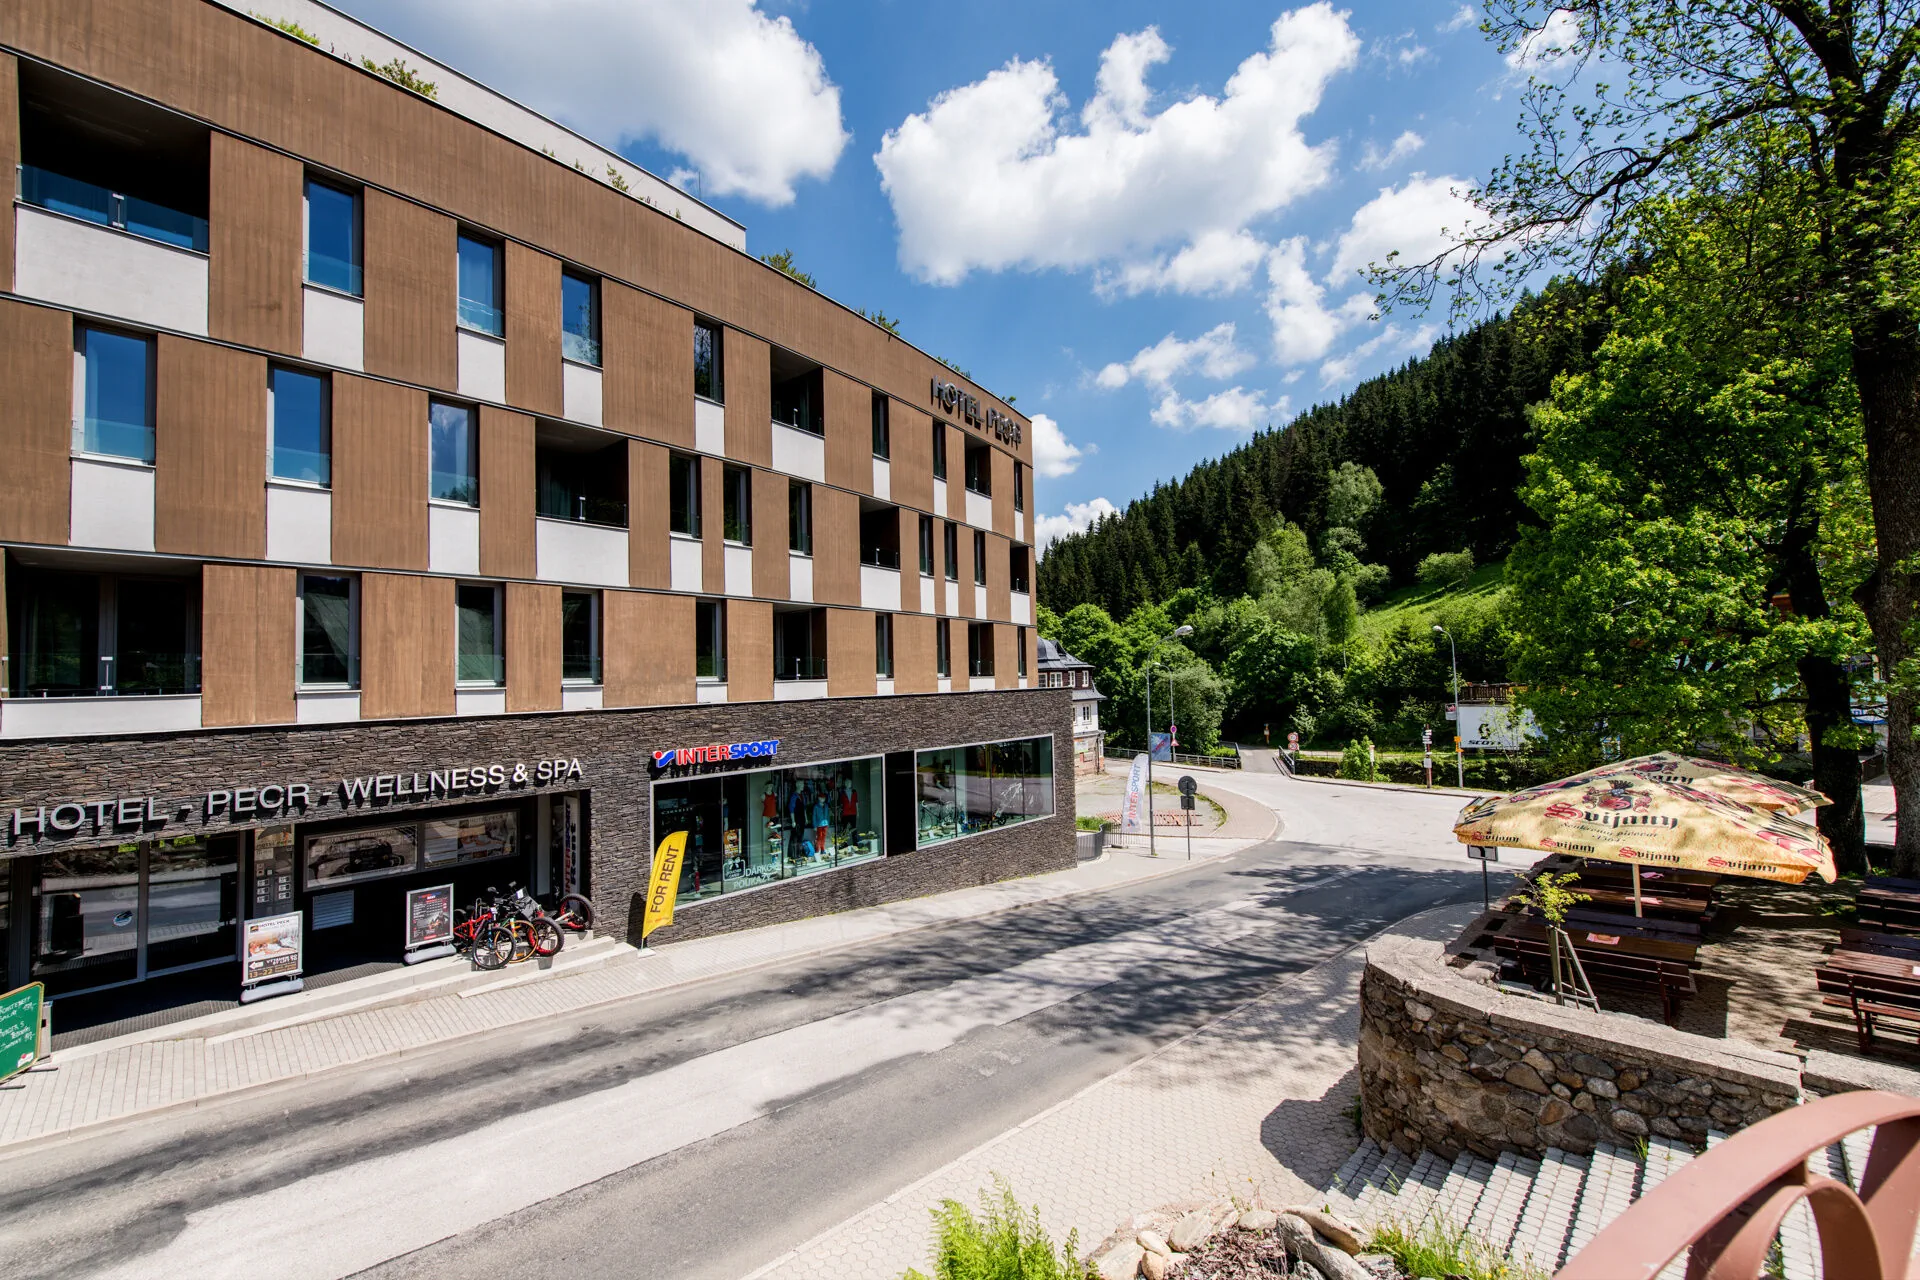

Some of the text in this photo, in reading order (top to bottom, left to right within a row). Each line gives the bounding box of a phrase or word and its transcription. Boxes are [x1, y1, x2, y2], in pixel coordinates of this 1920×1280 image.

[932, 376, 985, 423] HOTEL
[676, 740, 780, 766] INTERSPORT
[13, 796, 170, 836] HOTEL
[206, 783, 311, 815] PECR
[342, 764, 505, 801] WELLNESS
[512, 763, 529, 783] &
[536, 757, 583, 780] SPA
[1128, 763, 1141, 819] INTERSPORT
[1543, 802, 1678, 830] Svijany
[1471, 831, 1520, 844] Svijany
[1539, 837, 1595, 854] Svijany
[1618, 846, 1681, 864] Svijany
[1706, 855, 1777, 874] Svijany
[650, 884, 668, 914] FOR
[663, 845, 680, 882] RENT
